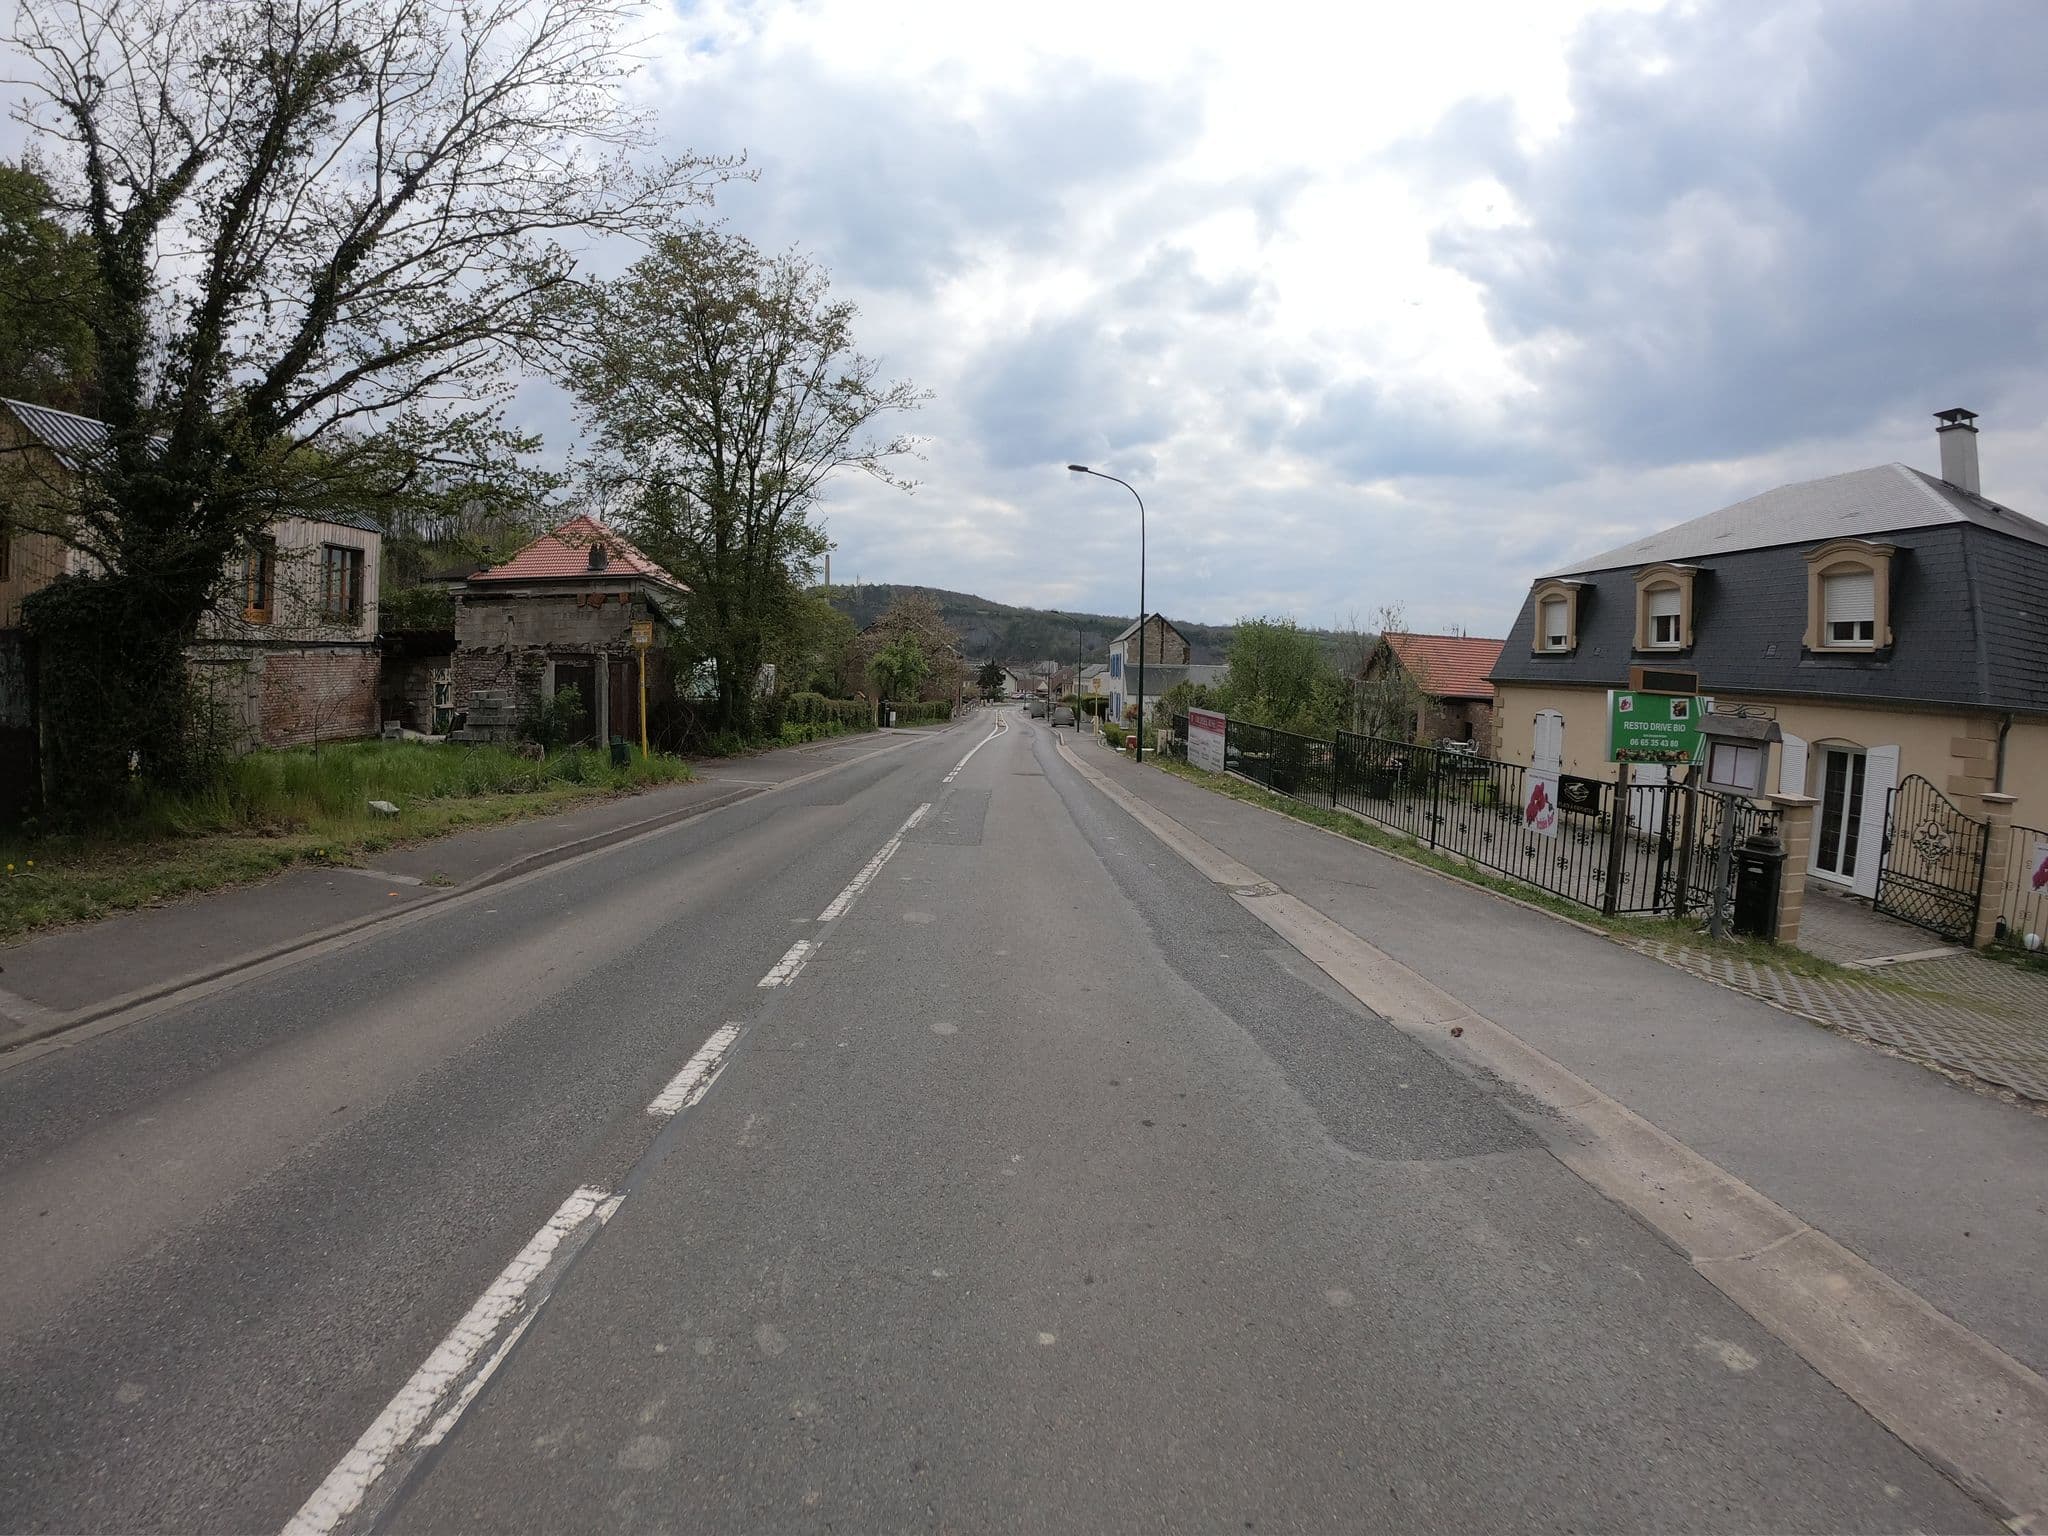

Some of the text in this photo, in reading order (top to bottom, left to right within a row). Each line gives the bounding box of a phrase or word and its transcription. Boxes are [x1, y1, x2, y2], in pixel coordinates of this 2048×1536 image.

[1623, 721, 1686, 732] RESTO DRIVE BIO
[1630, 738, 1639, 746] 06
[1660, 739, 1669, 747] 43
